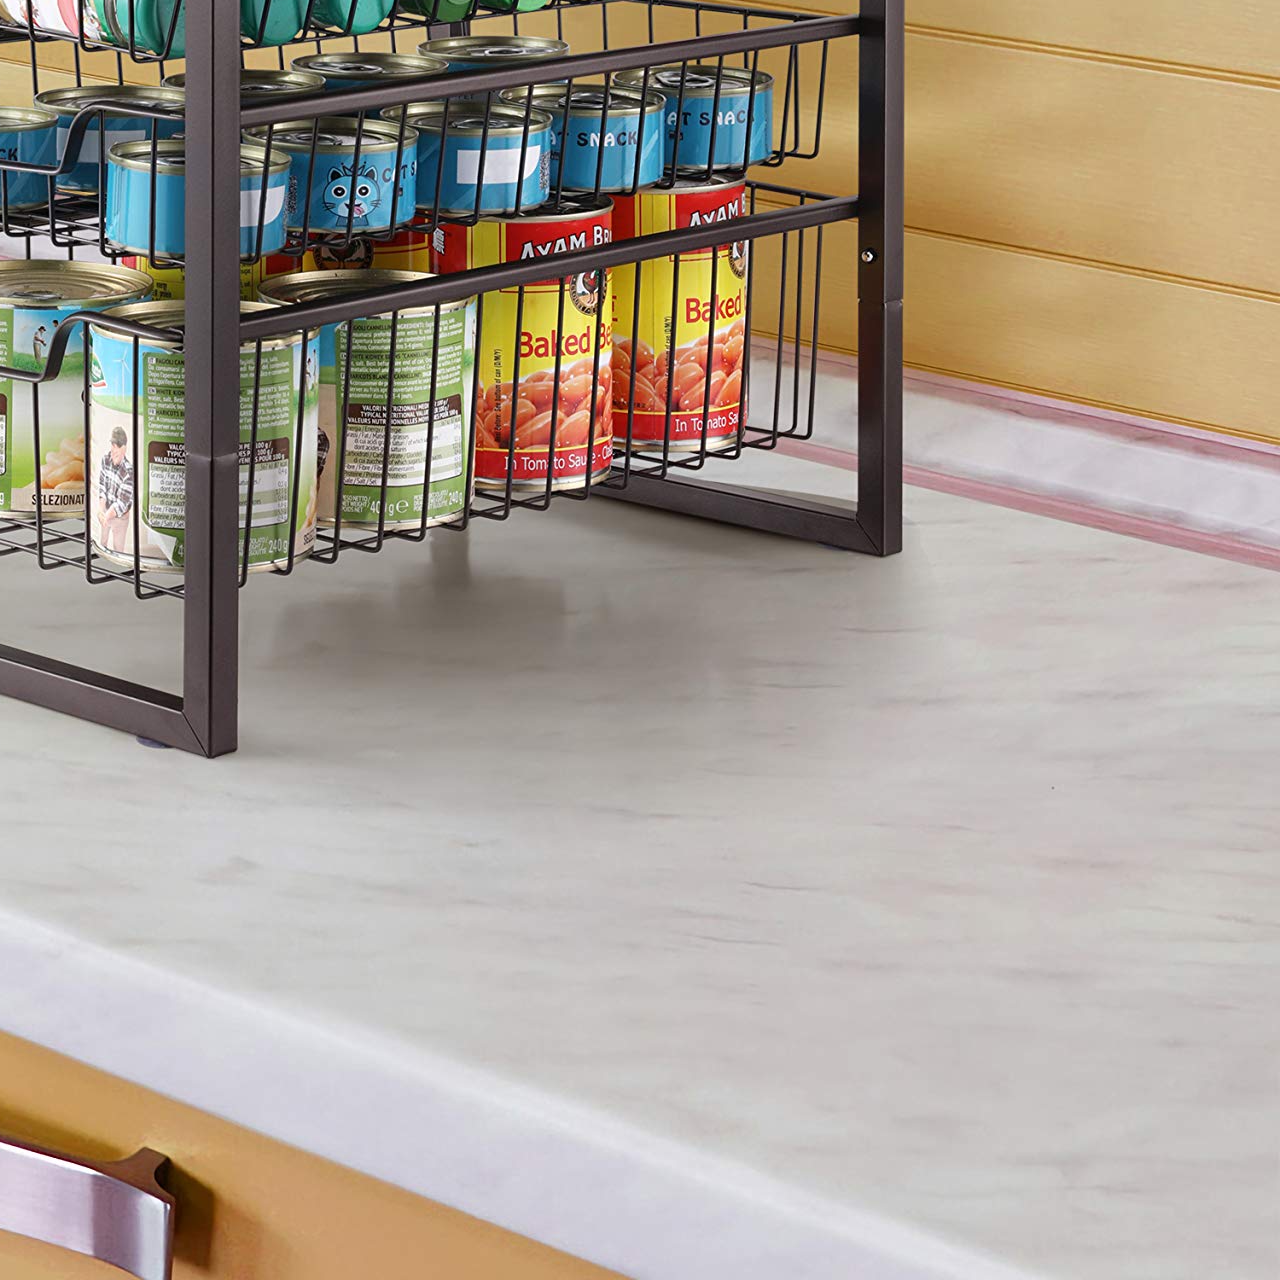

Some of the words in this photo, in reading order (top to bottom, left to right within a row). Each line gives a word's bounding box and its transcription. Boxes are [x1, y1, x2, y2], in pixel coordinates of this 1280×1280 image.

[577, 131, 638, 146] SNACK
[690, 198, 739, 227] AYAM
[521, 232, 586, 260] AYAM
[685, 288, 742, 324] Baked
[519, 326, 591, 358] Baked
[676, 419, 687, 433] In
[154, 456, 178, 464] VALEURS
[521, 456, 565, 470] Tomto
[569, 453, 596, 469] Saue
[370, 500, 387, 514] 40
[268, 539, 281, 554] 240
[283, 540, 289, 554] g
